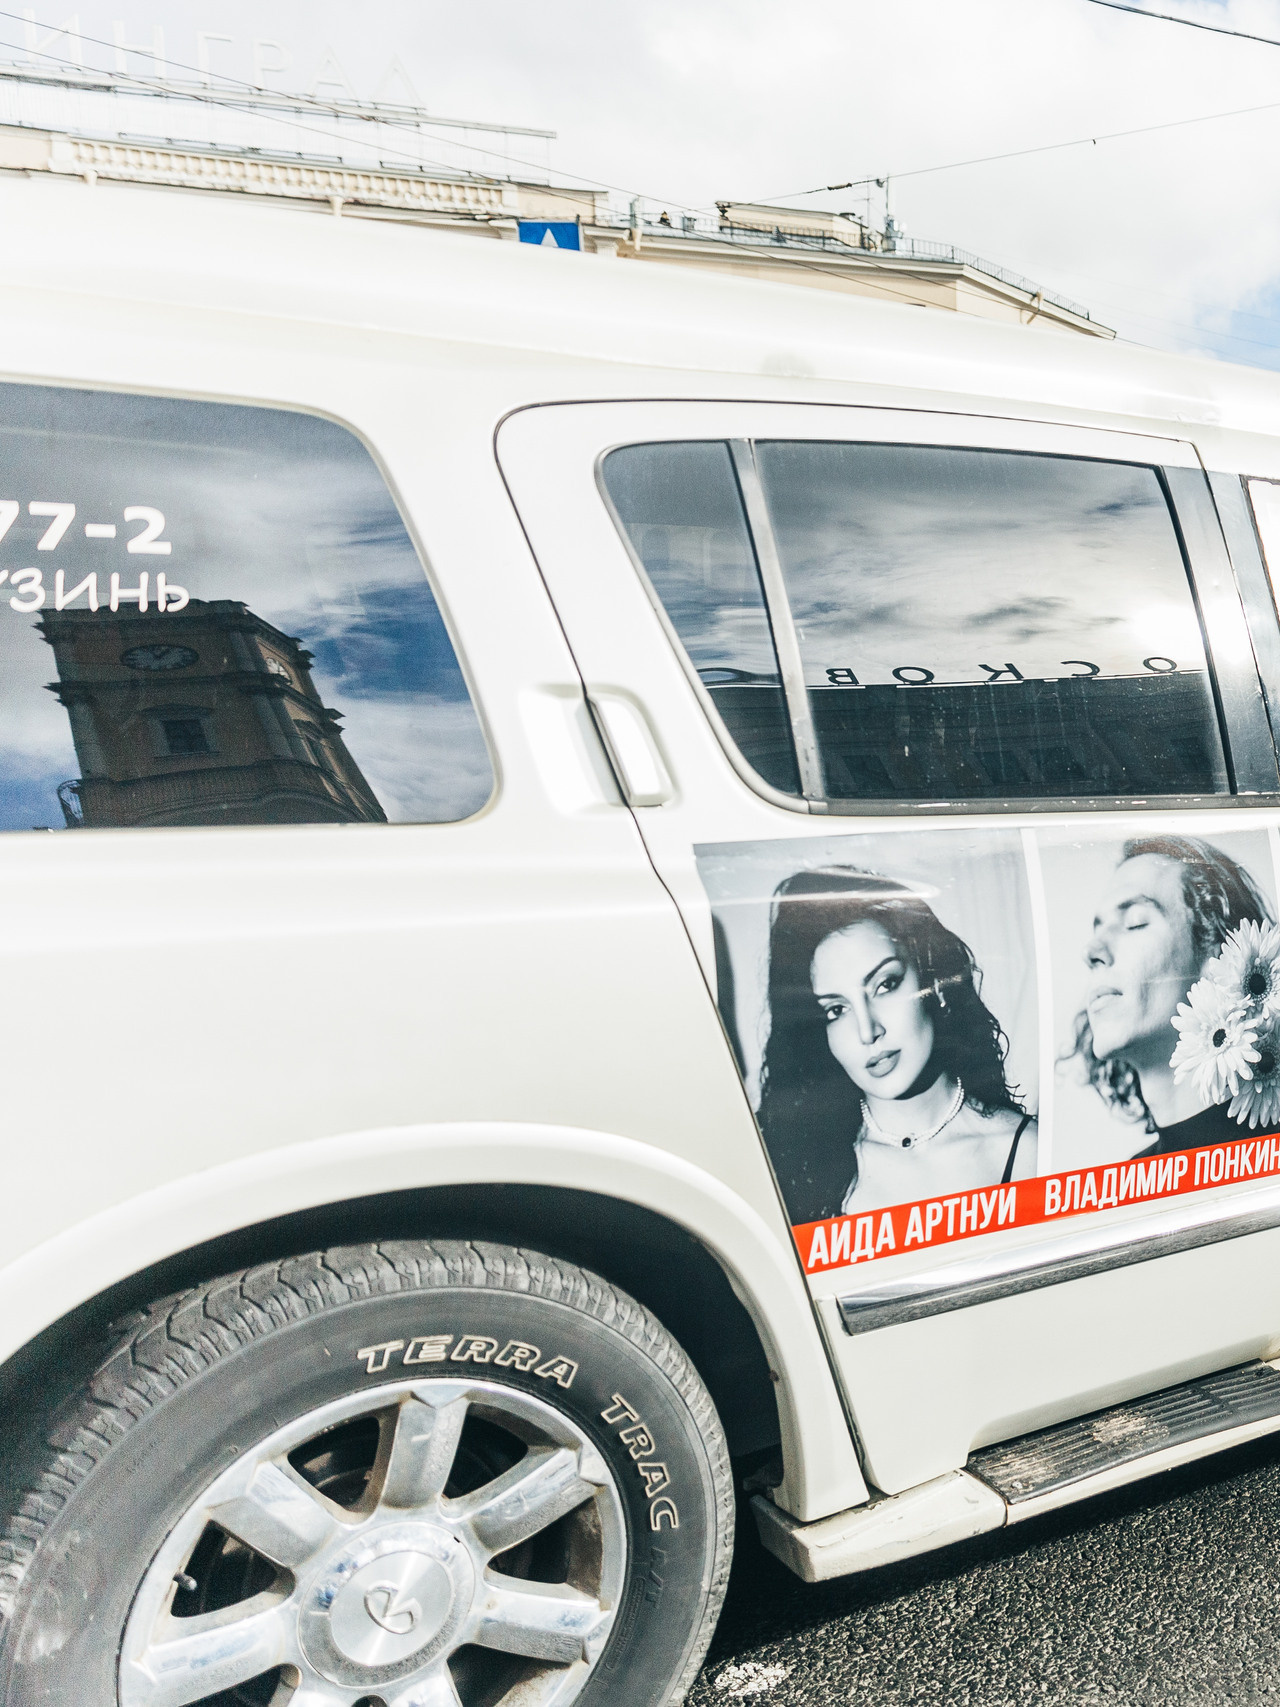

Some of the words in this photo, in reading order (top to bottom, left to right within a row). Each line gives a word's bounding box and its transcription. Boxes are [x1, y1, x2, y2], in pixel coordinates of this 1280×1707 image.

[1044, 1155, 1188, 1216] ВЛАДИМИР
[807, 1211, 896, 1269] АИДА
[904, 1186, 1017, 1247] АРТНУИ
[357, 1334, 580, 1388] TERRA
[601, 1392, 680, 1531] TRAC
